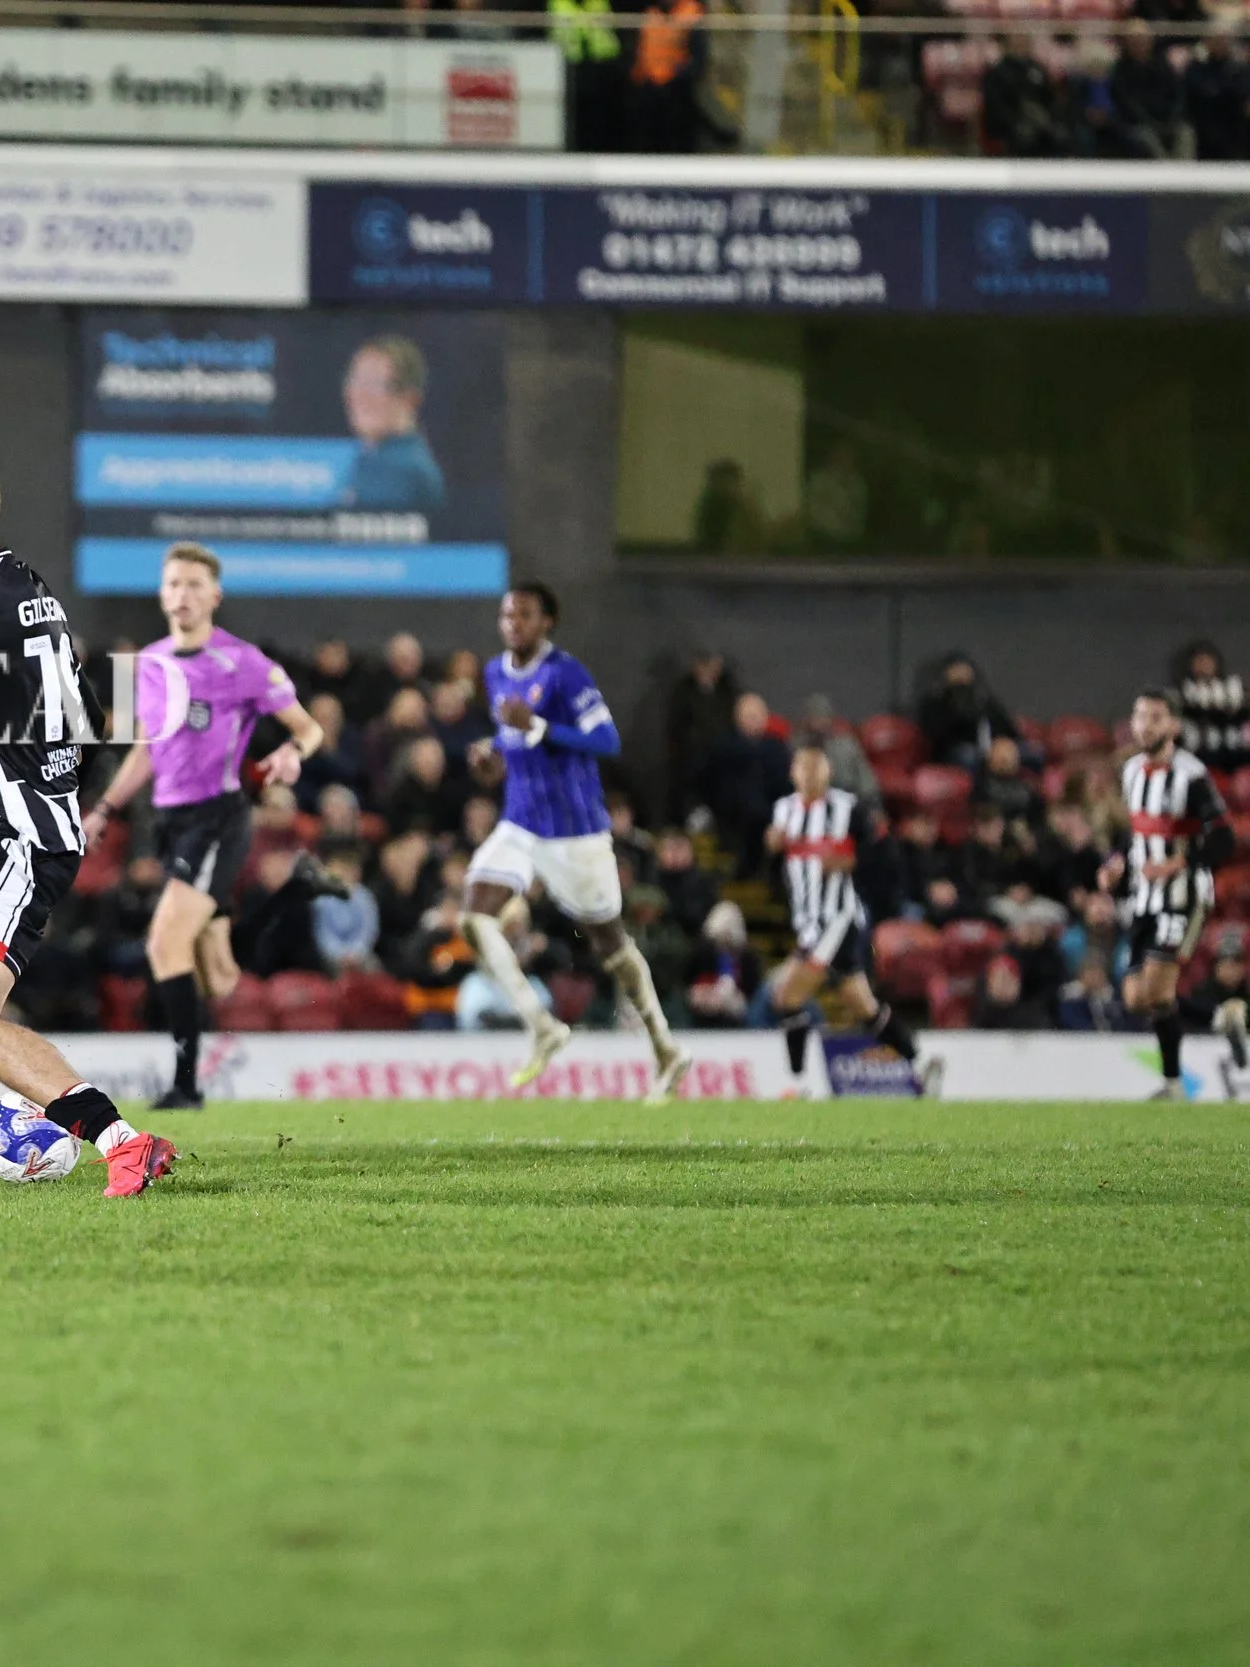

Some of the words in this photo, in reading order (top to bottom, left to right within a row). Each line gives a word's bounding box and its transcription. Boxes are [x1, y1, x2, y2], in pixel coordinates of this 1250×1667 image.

[112, 63, 244, 121] family
[265, 71, 385, 114] stand
[778, 271, 887, 306] Support
